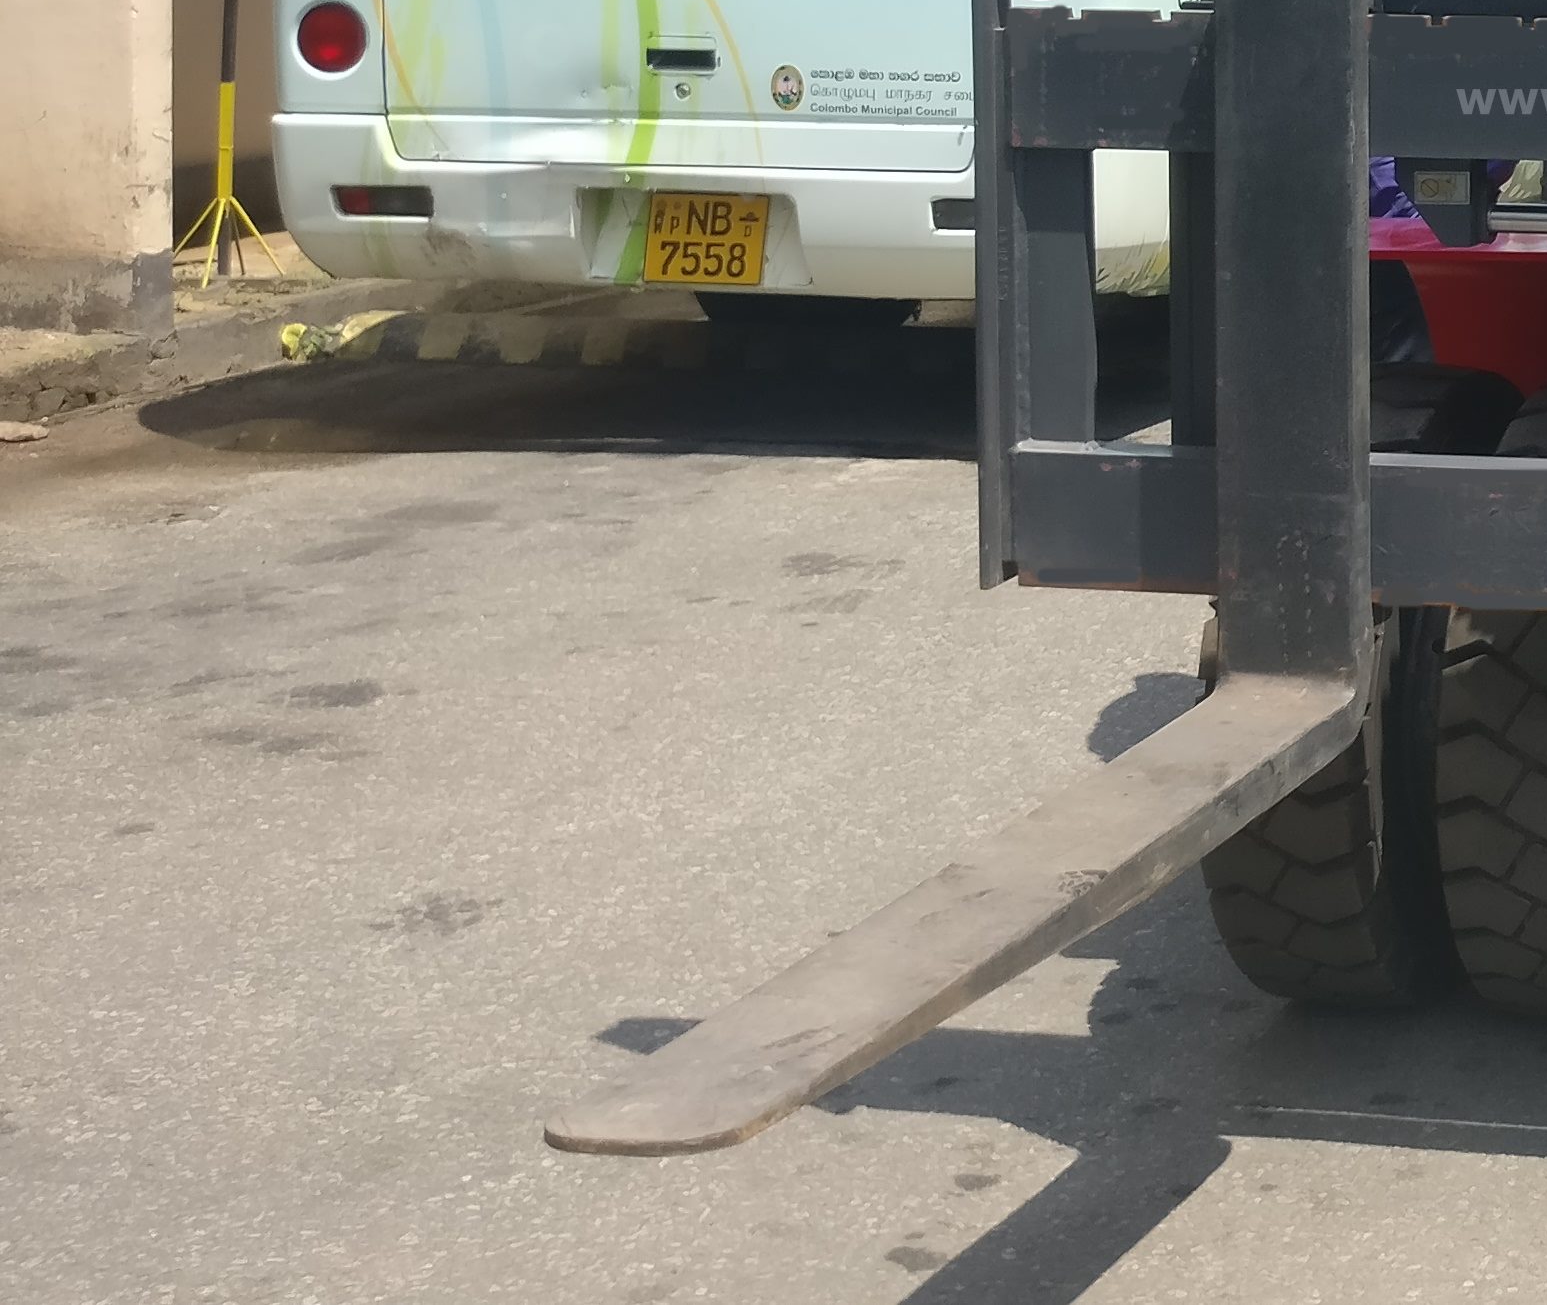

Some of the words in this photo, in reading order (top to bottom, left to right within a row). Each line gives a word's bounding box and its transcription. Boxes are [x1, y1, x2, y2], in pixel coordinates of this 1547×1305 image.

[810, 102, 858, 114] Colombo
[861, 104, 912, 117] Municipal
[916, 106, 957, 117] Council
[686, 200, 732, 236] NB
[660, 241, 746, 277] 7558
